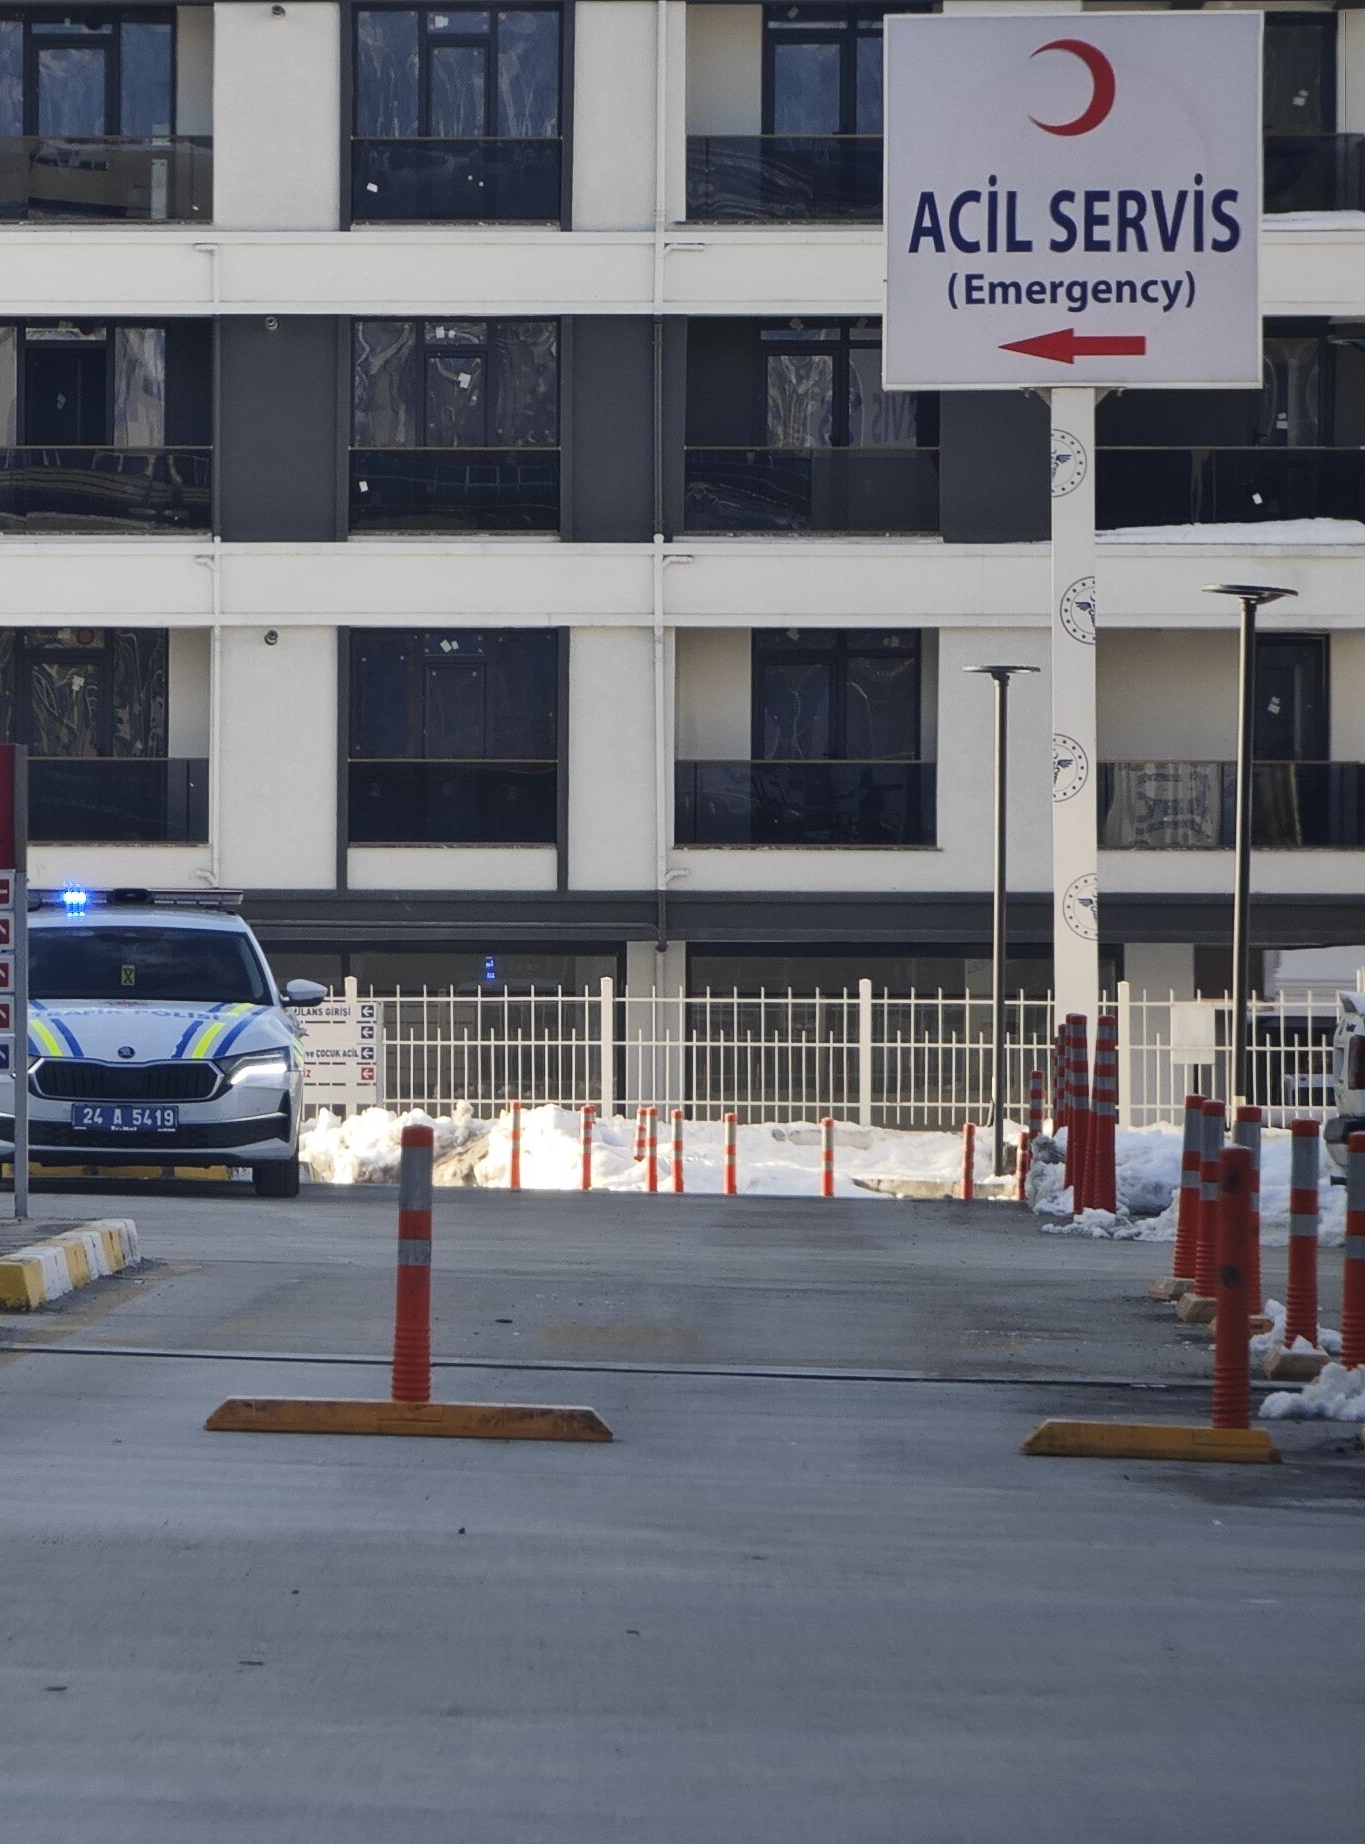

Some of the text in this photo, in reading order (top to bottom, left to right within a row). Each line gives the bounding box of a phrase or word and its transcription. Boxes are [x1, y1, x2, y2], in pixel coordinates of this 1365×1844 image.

[907, 173, 1241, 254] ACİL SERVİS
[947, 270, 1196, 313] (Emergency)
[83, 1108, 174, 1126] 24 A 5419
